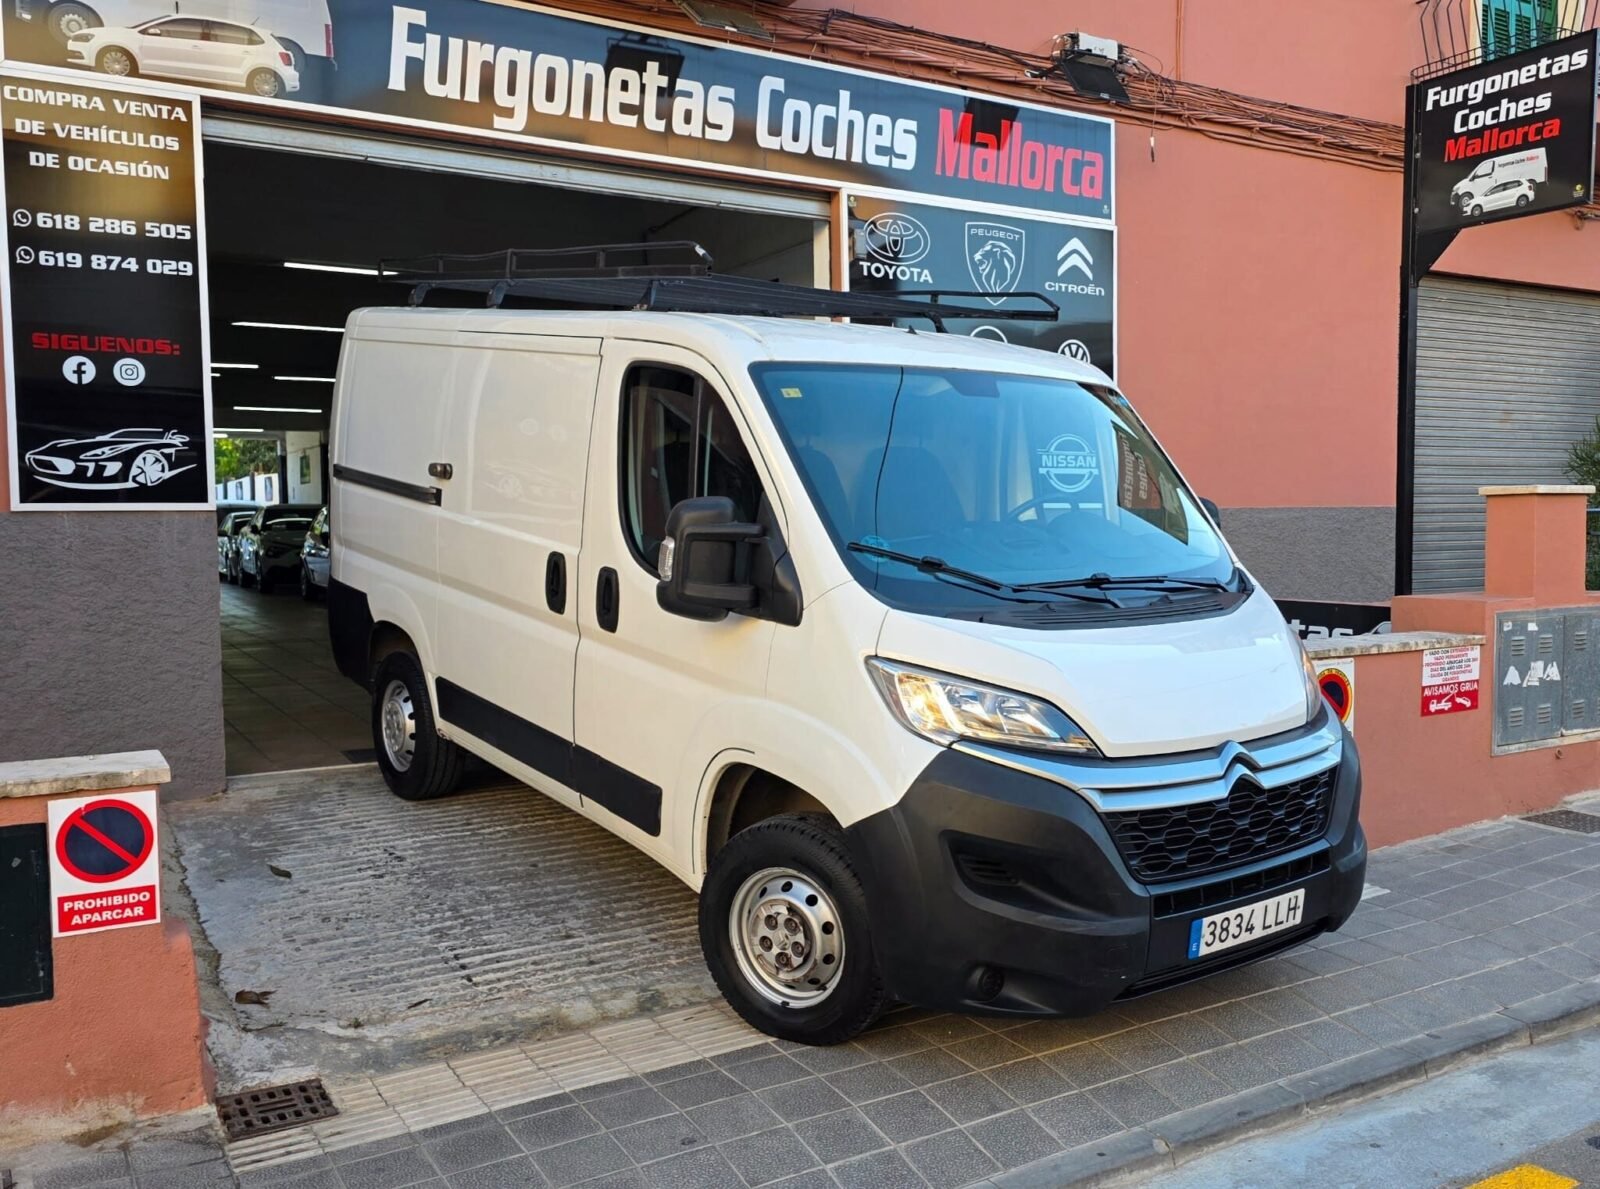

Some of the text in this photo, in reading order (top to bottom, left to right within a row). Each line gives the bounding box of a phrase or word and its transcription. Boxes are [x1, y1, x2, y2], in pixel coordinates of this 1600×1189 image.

[1426, 49, 1588, 111] Furgonetas
[3, 85, 187, 122] COMPRA VENTA
[387, 5, 1104, 200] Furgonetas Coches Mallorca
[1453, 92, 1552, 134] Coches
[14, 118, 180, 151] DE VEHÍCULOS
[1444, 118, 1561, 162] Mallorca
[28, 151, 170, 180] DE OCASIÓN
[36, 212, 192, 240] 618 286 505
[970, 228, 1020, 241] PEUGEOT
[38, 250, 193, 276] 619 874 029
[859, 261, 933, 284] TOYOTA
[31, 332, 181, 355] SIGUENOS:
[1041, 454, 1097, 468] NISSAN
[1423, 681, 1478, 697] AVISAMOS GRUA
[63, 891, 151, 913] PROHIBIDO
[71, 906, 144, 926] APARCAR
[1205, 895, 1299, 947] 3834 LLH
